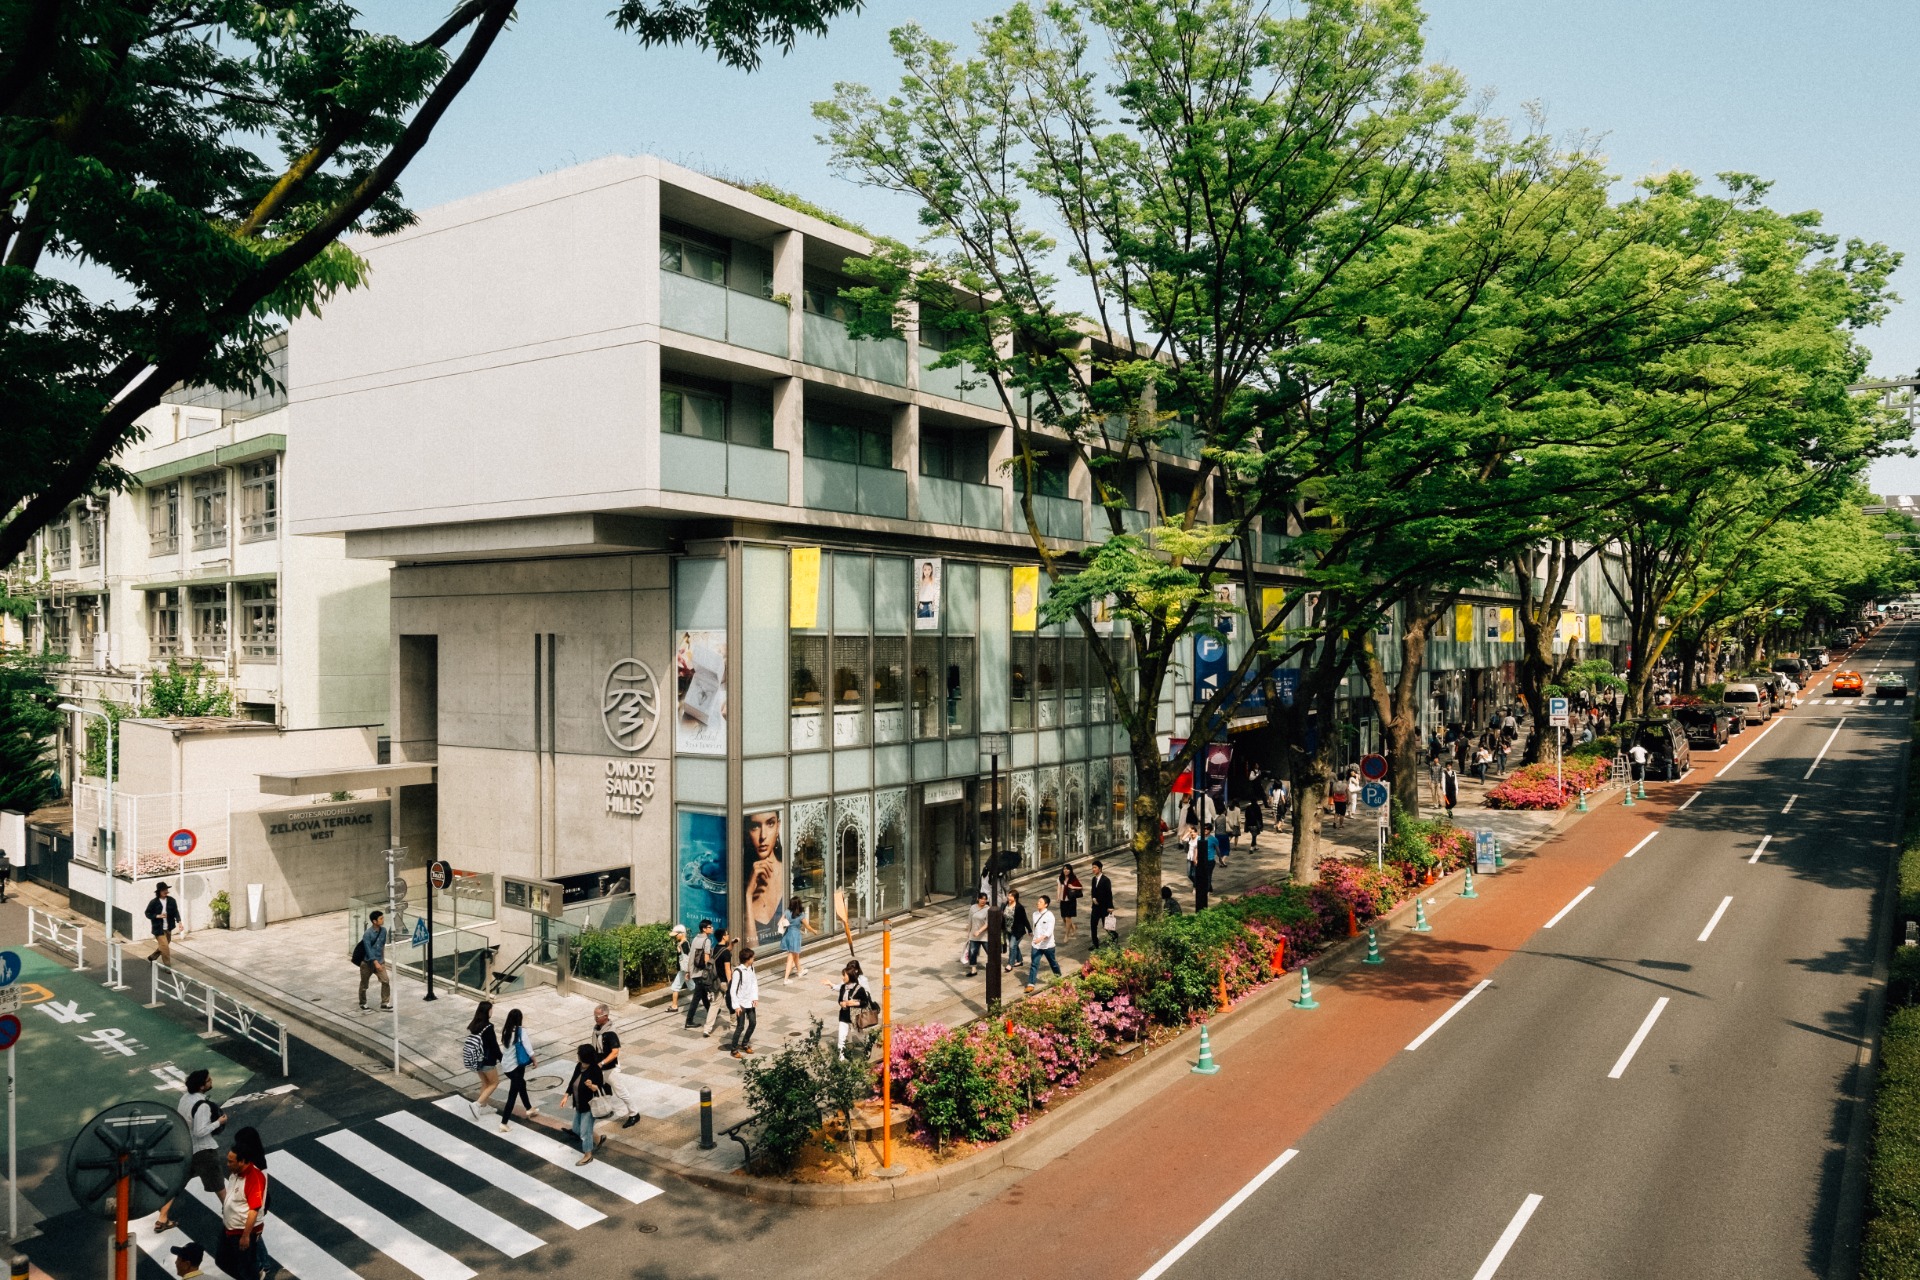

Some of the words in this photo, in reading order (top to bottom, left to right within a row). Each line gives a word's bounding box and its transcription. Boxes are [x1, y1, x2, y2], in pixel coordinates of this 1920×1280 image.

[1203, 640, 1219, 656] P
[1551, 699, 1566, 714] P
[606, 760, 656, 778] OMOTE
[606, 778, 655, 798] SANDO
[1366, 787, 1377, 804] P
[605, 795, 644, 815] HILLS
[288, 809, 337, 821] OMOTESANDO
[337, 807, 356, 816] HILLS
[270, 821, 321, 835] ZELKOVA
[322, 814, 373, 828] TERRACE
[310, 830, 335, 841] WEST
[686, 911, 699, 920] STAR
